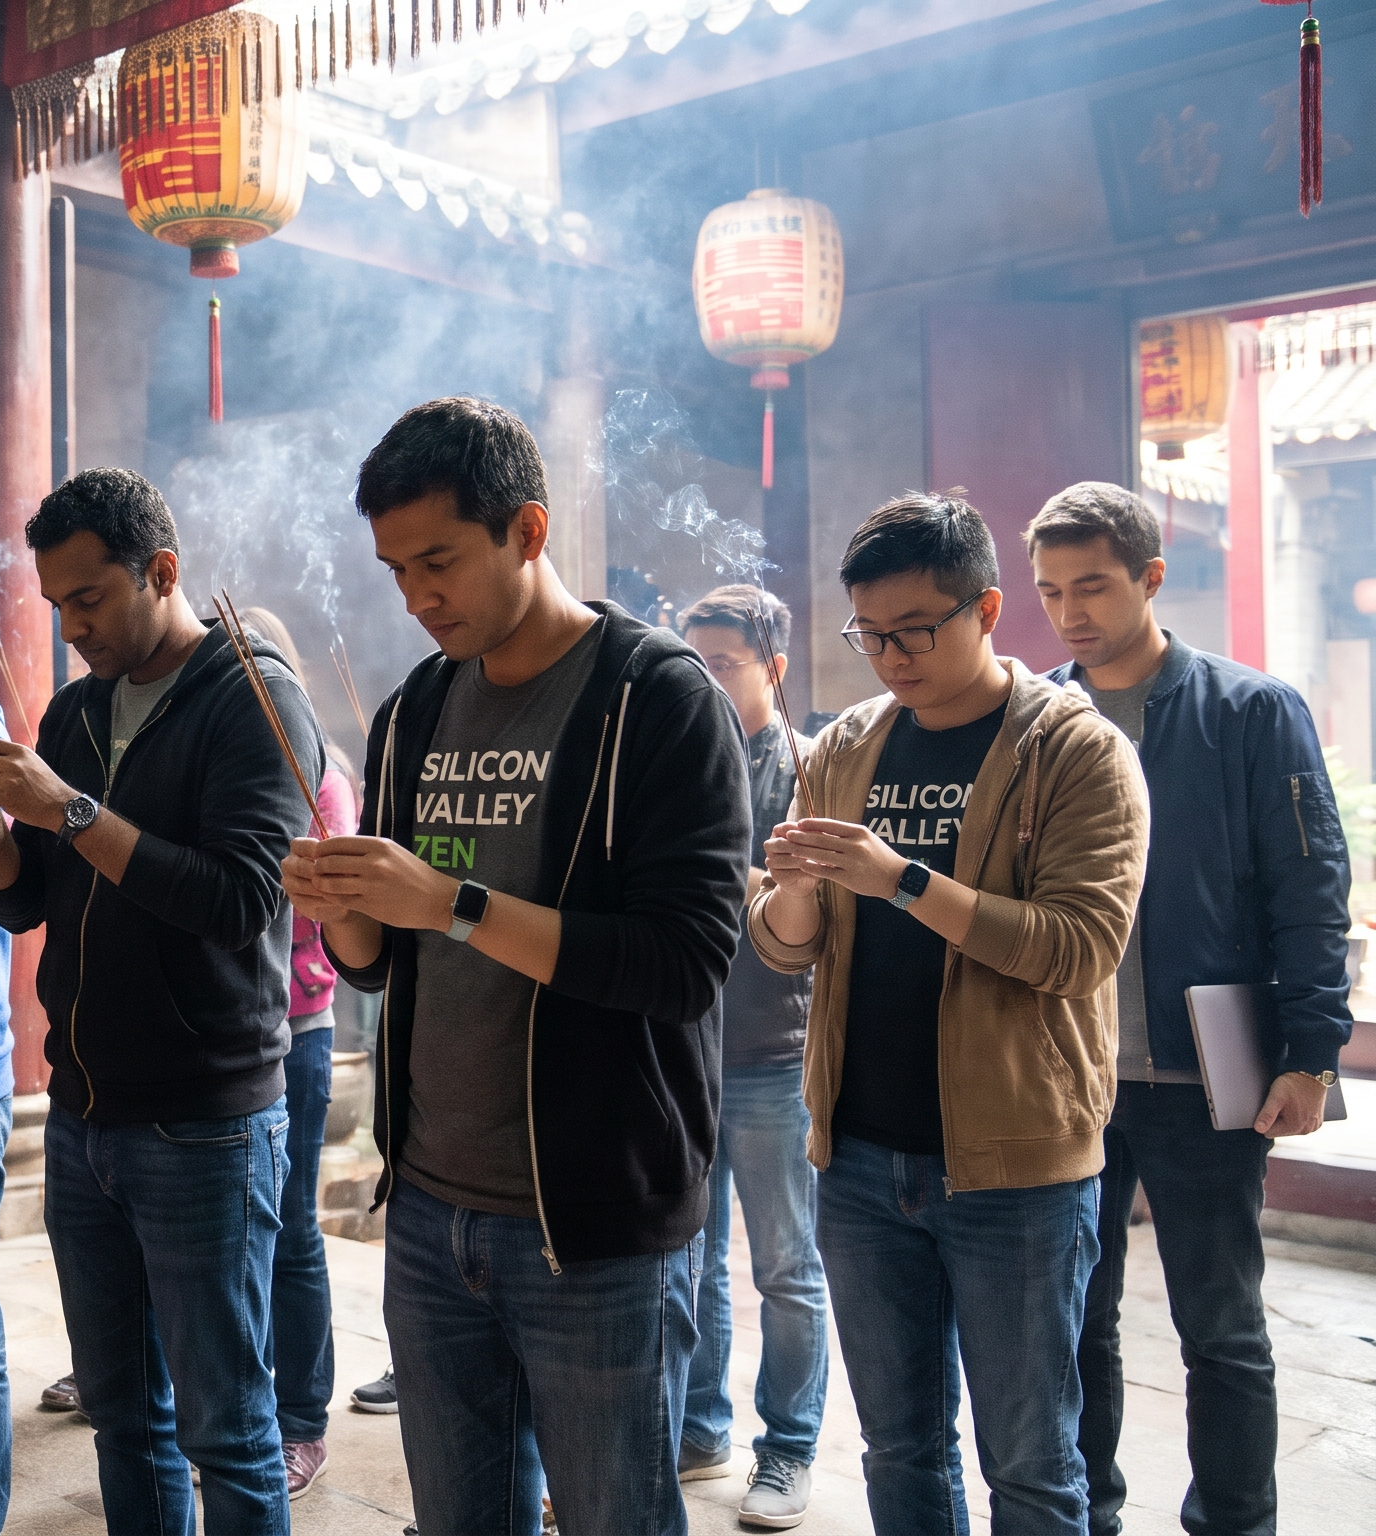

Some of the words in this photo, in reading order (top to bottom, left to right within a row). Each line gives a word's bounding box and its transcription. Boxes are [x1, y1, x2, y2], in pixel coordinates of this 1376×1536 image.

[420, 750, 552, 782] SILICON
[416, 792, 536, 825] VALLEY
[414, 835, 476, 869] ZEN
